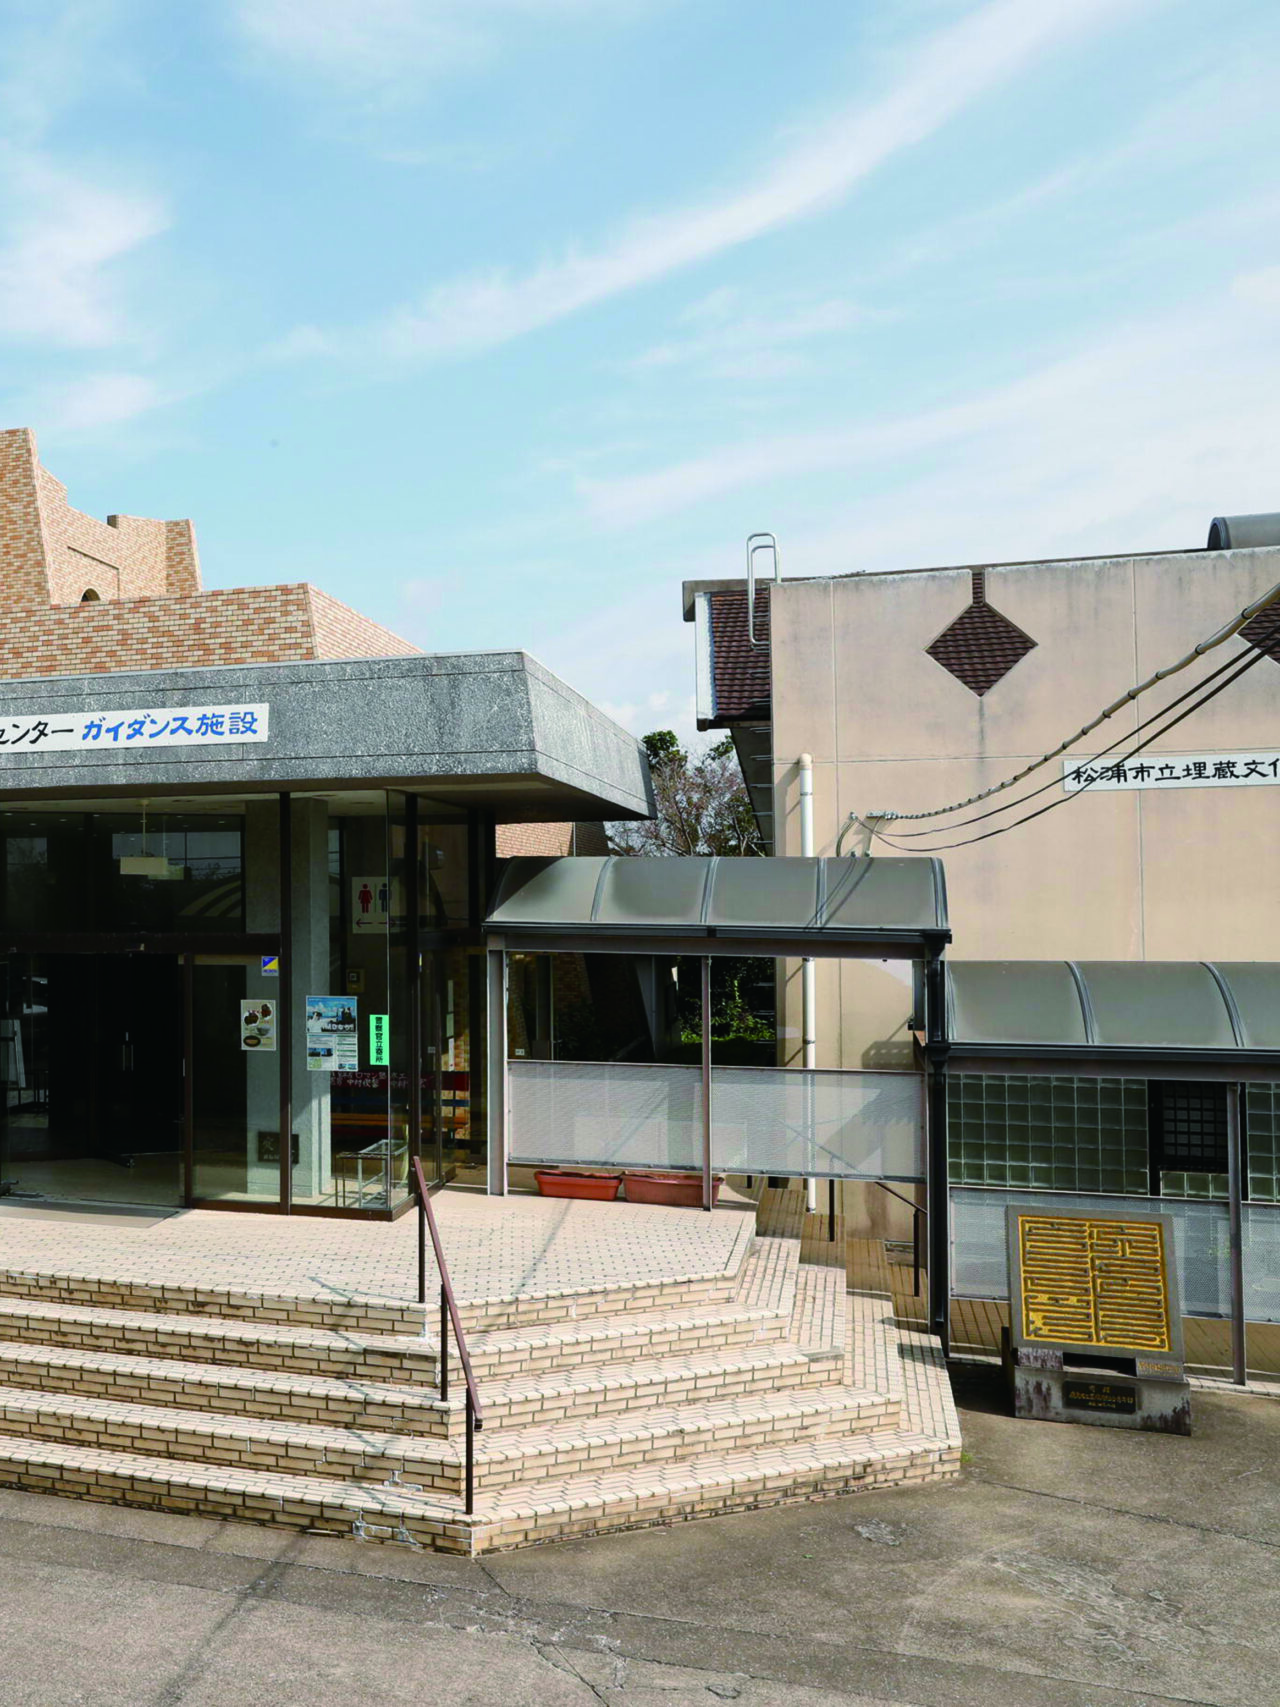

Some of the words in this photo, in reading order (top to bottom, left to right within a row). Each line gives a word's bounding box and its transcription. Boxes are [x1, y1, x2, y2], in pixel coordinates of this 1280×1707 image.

[82, 711, 258, 742] ガイダンス施設
